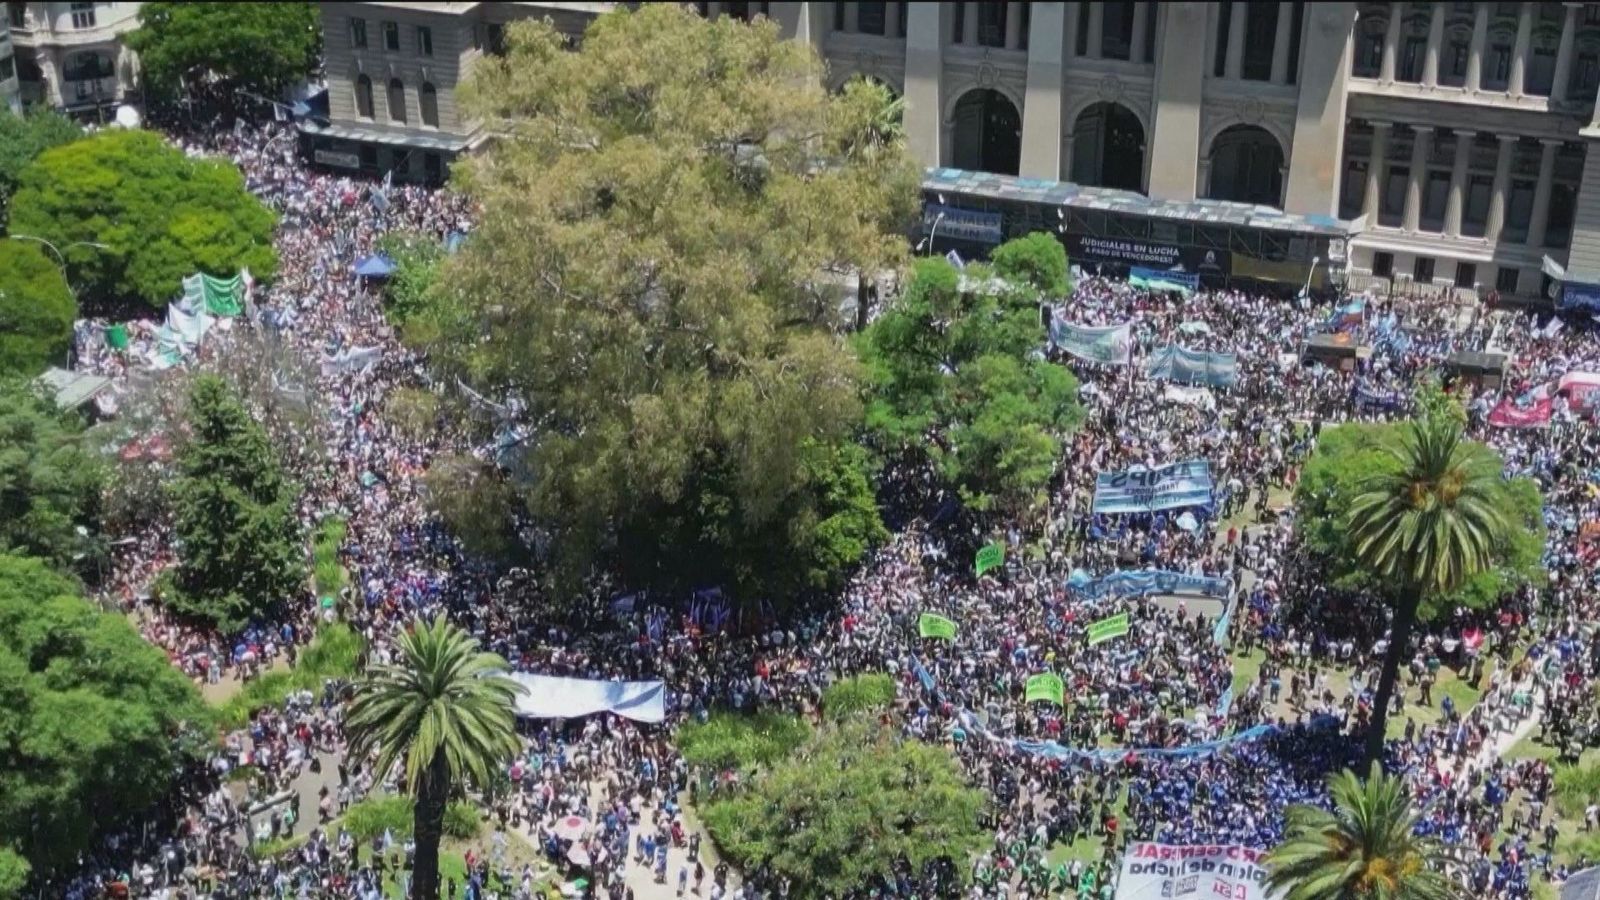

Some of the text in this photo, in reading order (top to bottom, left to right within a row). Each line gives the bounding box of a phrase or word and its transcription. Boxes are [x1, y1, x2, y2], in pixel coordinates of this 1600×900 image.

[1080, 237, 1179, 256] JUDICIALES EN LUCHA
[1091, 248, 1110, 256] PASO
